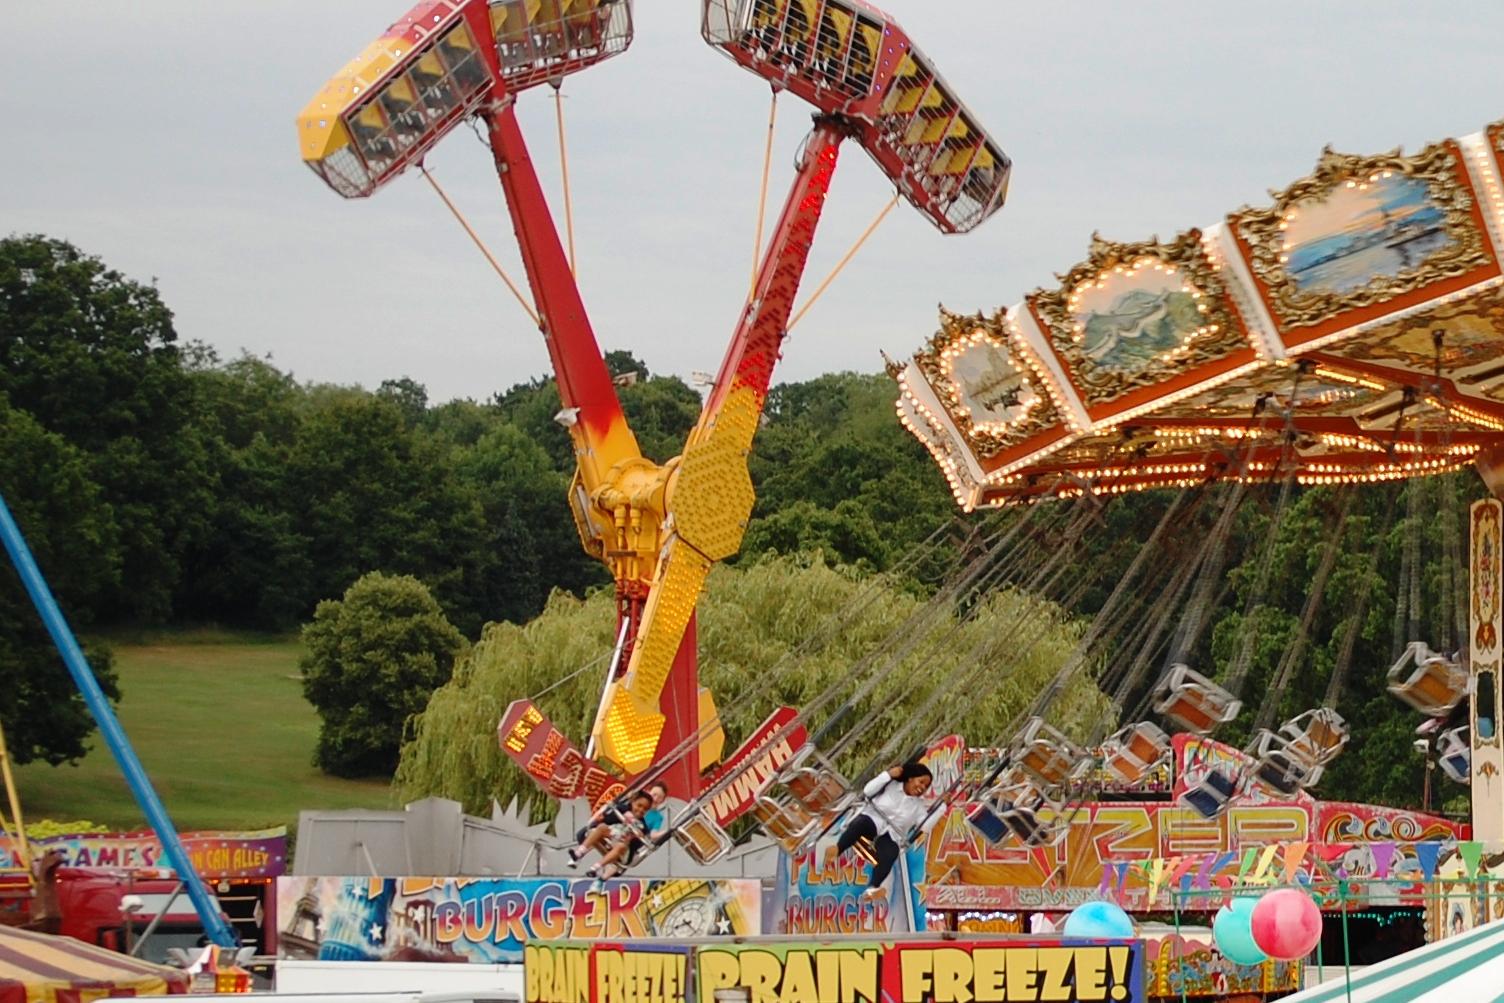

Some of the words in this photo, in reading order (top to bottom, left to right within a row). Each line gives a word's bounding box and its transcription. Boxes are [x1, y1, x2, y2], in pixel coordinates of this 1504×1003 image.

[207, 847, 230, 870] CAN
[234, 847, 269, 871] ALLEY
[935, 805, 1311, 866] ALTZER
[791, 847, 870, 886] PLANE
[434, 878, 651, 943] BURGER
[787, 892, 890, 934] BURGER
[526, 945, 591, 1003] BRAIN
[595, 950, 688, 1003] FREEZE!
[899, 946, 1131, 1003] FREEZE!
